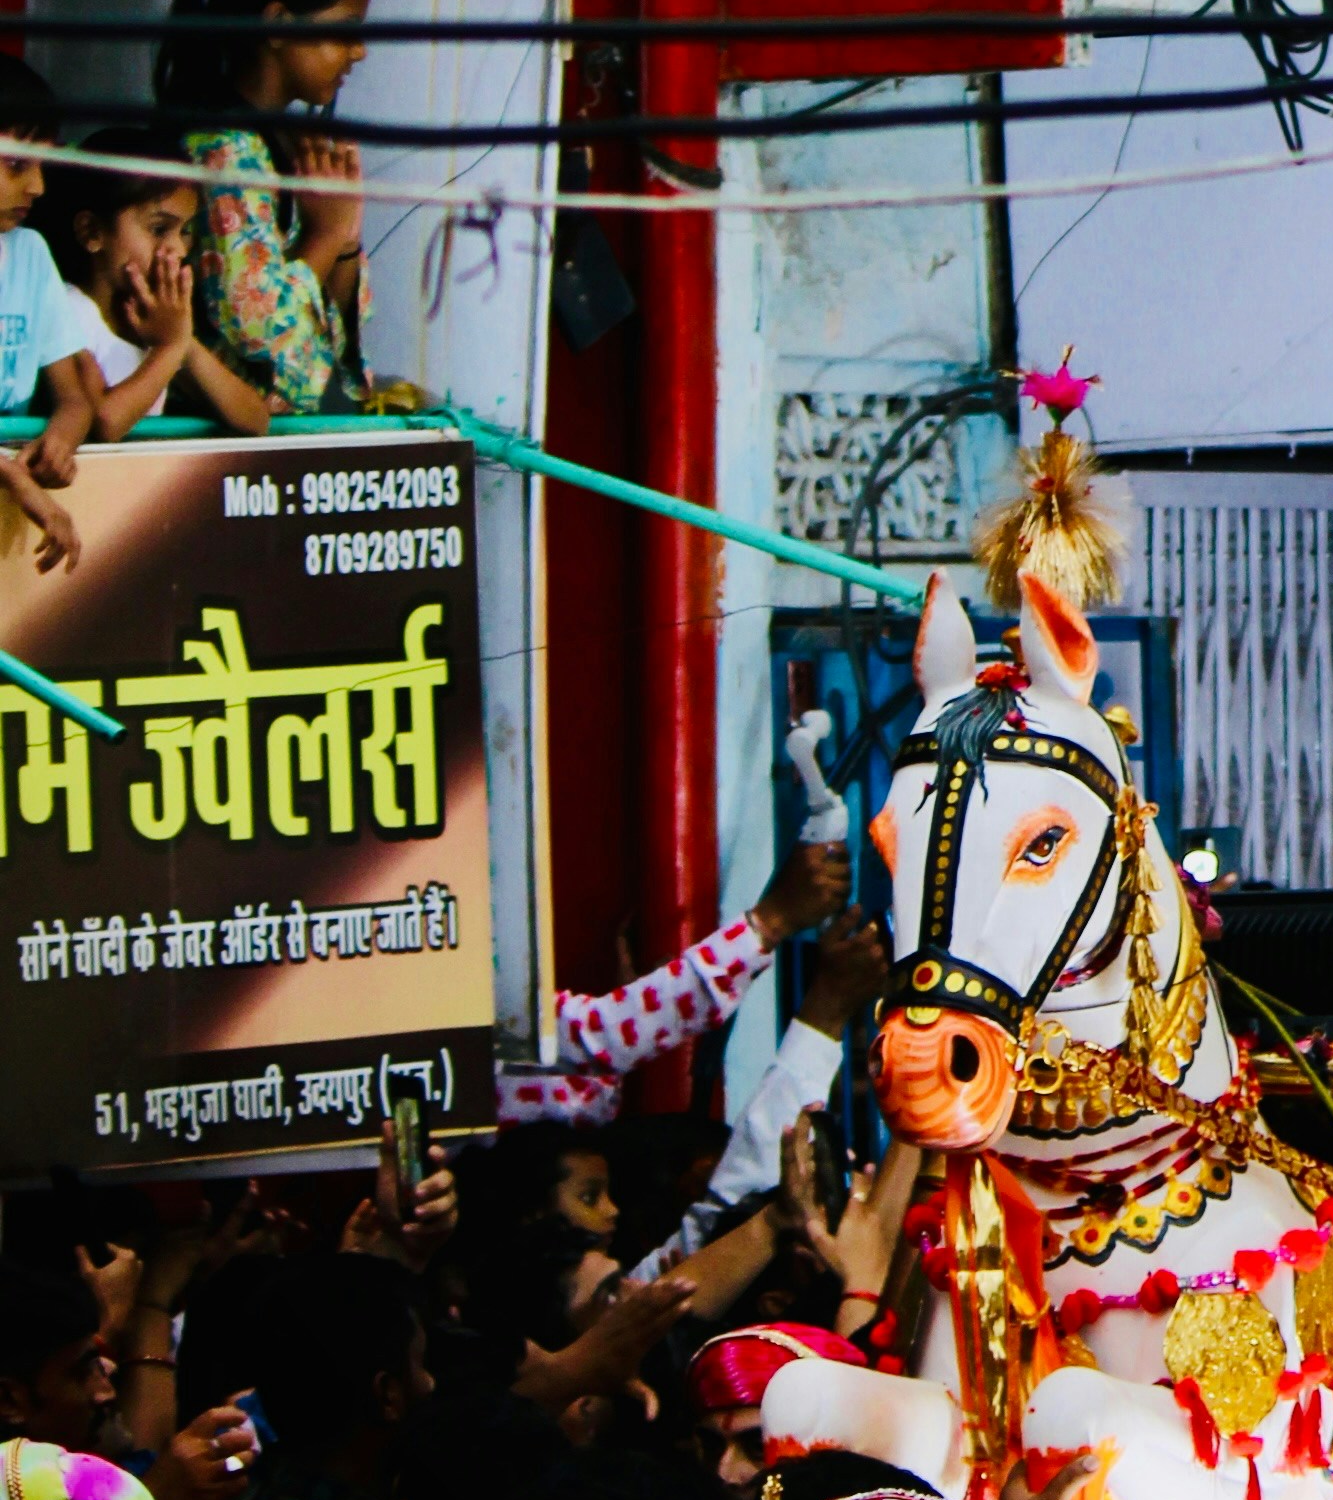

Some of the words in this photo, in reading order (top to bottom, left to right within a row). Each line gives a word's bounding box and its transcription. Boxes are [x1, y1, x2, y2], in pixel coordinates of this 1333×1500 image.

[223, 474, 280, 517] Mob
[301, 464, 461, 514] 9982542093
[304, 525, 463, 576] 8769289750
[116, 603, 449, 841] ज्वैलर्स
[17, 919, 71, 982] सोने
[128, 911, 158, 972] के
[158, 908, 217, 969] जेवर
[219, 901, 283, 965] ऑर्डर
[284, 899, 308, 960] से
[308, 907, 373, 957] बनाए
[373, 888, 423, 949] जाते
[94, 1091, 141, 1143] 51,
[231, 1063, 292, 1126] घाटी,
[294, 1066, 374, 1126] उदयपुर
